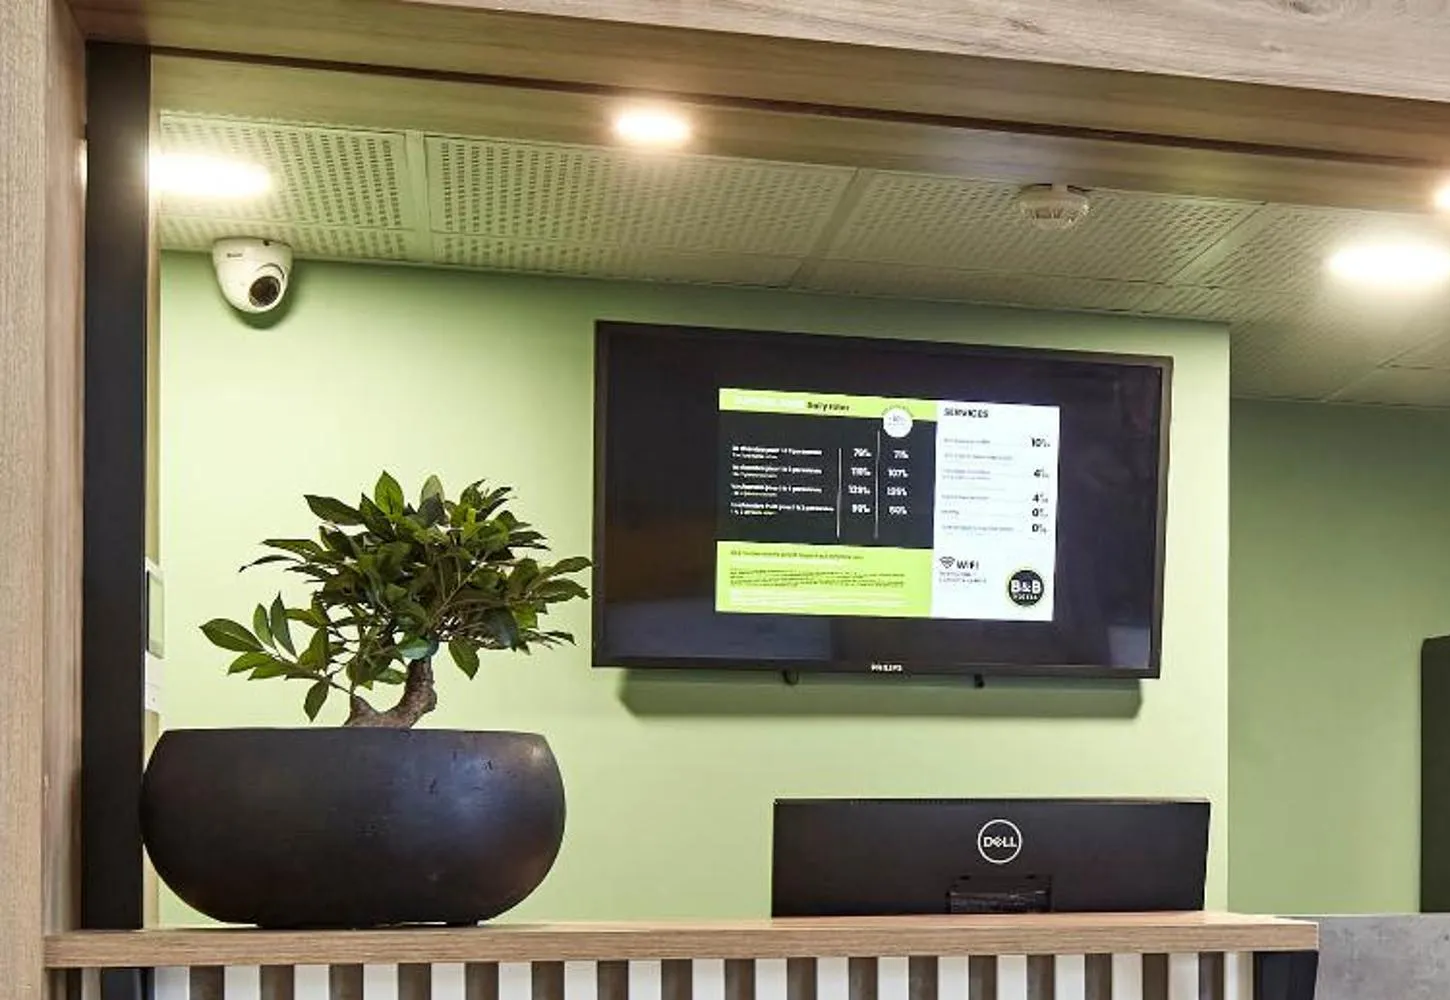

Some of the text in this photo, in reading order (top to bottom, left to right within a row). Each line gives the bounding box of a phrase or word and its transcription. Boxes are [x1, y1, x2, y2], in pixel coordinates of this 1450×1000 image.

[943, 407, 989, 419] SERVICES
[1010, 579, 1041, 594] B&B
[983, 836, 1018, 848] DELL
